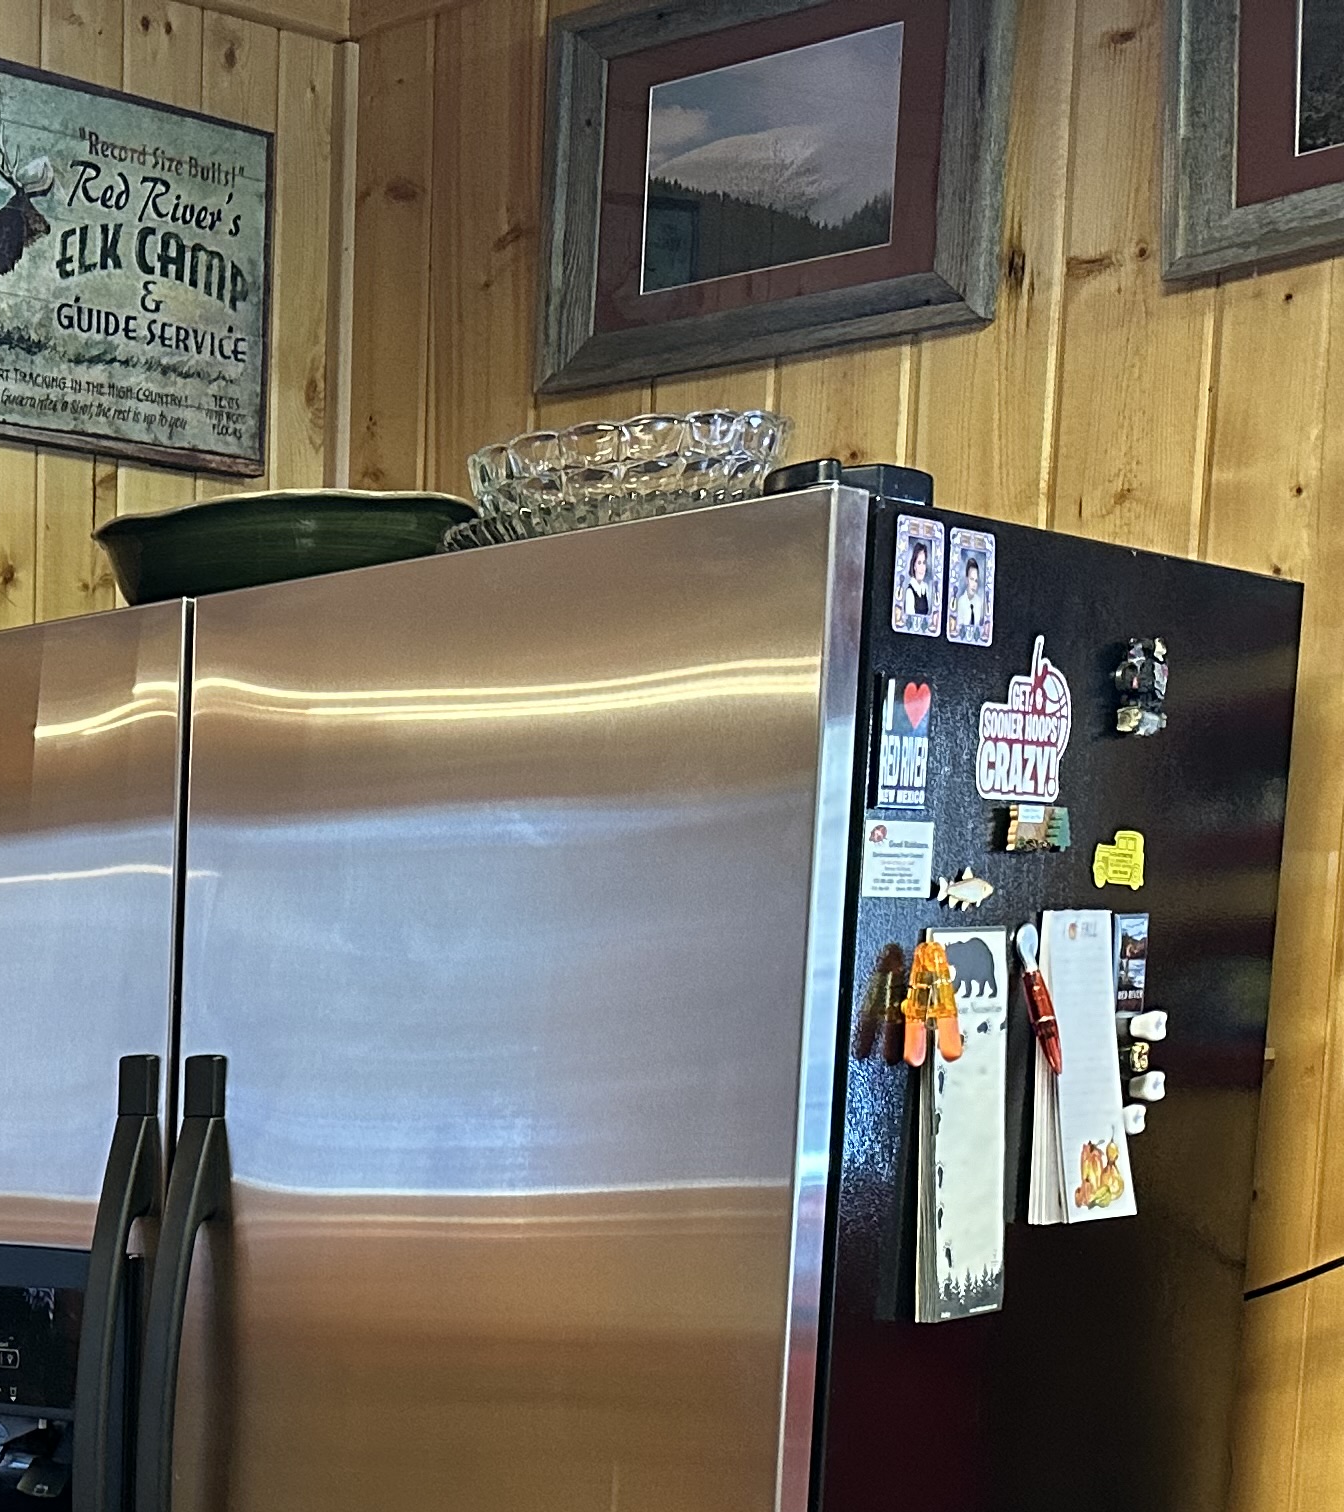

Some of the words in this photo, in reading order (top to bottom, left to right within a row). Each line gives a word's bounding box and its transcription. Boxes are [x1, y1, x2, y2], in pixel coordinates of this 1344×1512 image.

[151, 147, 184, 177] Size
[67, 160, 131, 211] Red
[137, 176, 242, 238] River's
[55, 223, 124, 280] ELK
[135, 226, 249, 313] CAMP
[140, 280, 164, 313] &
[56, 294, 138, 341] GUIDE
[145, 319, 248, 363] SERVICE
[13, 368, 67, 391] TRACKING
[70, 378, 82, 394] IN
[85, 381, 107, 396] THE
[107, 382, 133, 400] HIGH
[94, 402, 112, 419] the
[112, 406, 131, 423] rest
[132, 410, 140, 422] is
[143, 413, 157, 431] up
[158, 411, 168, 426] to
[169, 415, 188, 440] you
[885, 679, 896, 731] I
[983, 708, 1024, 741] SOONER
[1024, 713, 1058, 744] HOOPS
[879, 734, 900, 788] RED
[900, 736, 928, 788] RIVER
[979, 740, 1058, 797] CRAZY!
[896, 790, 925, 804] MEXICO
